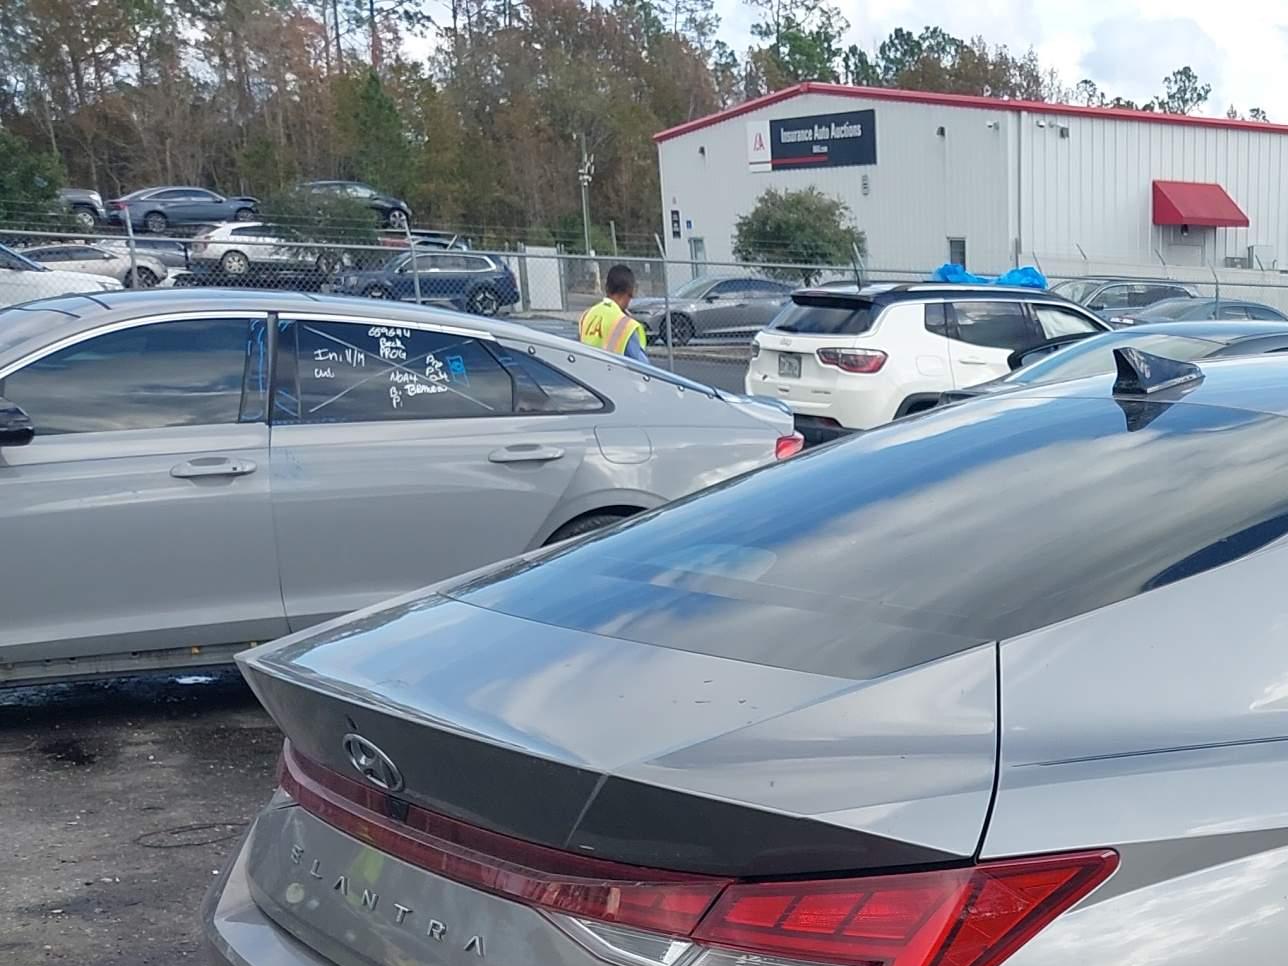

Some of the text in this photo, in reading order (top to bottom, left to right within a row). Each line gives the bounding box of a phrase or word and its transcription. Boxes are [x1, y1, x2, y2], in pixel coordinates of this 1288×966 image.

[781, 121, 862, 143] Insurance Auto Auctions
[290, 844, 487, 958] ELANTRA
